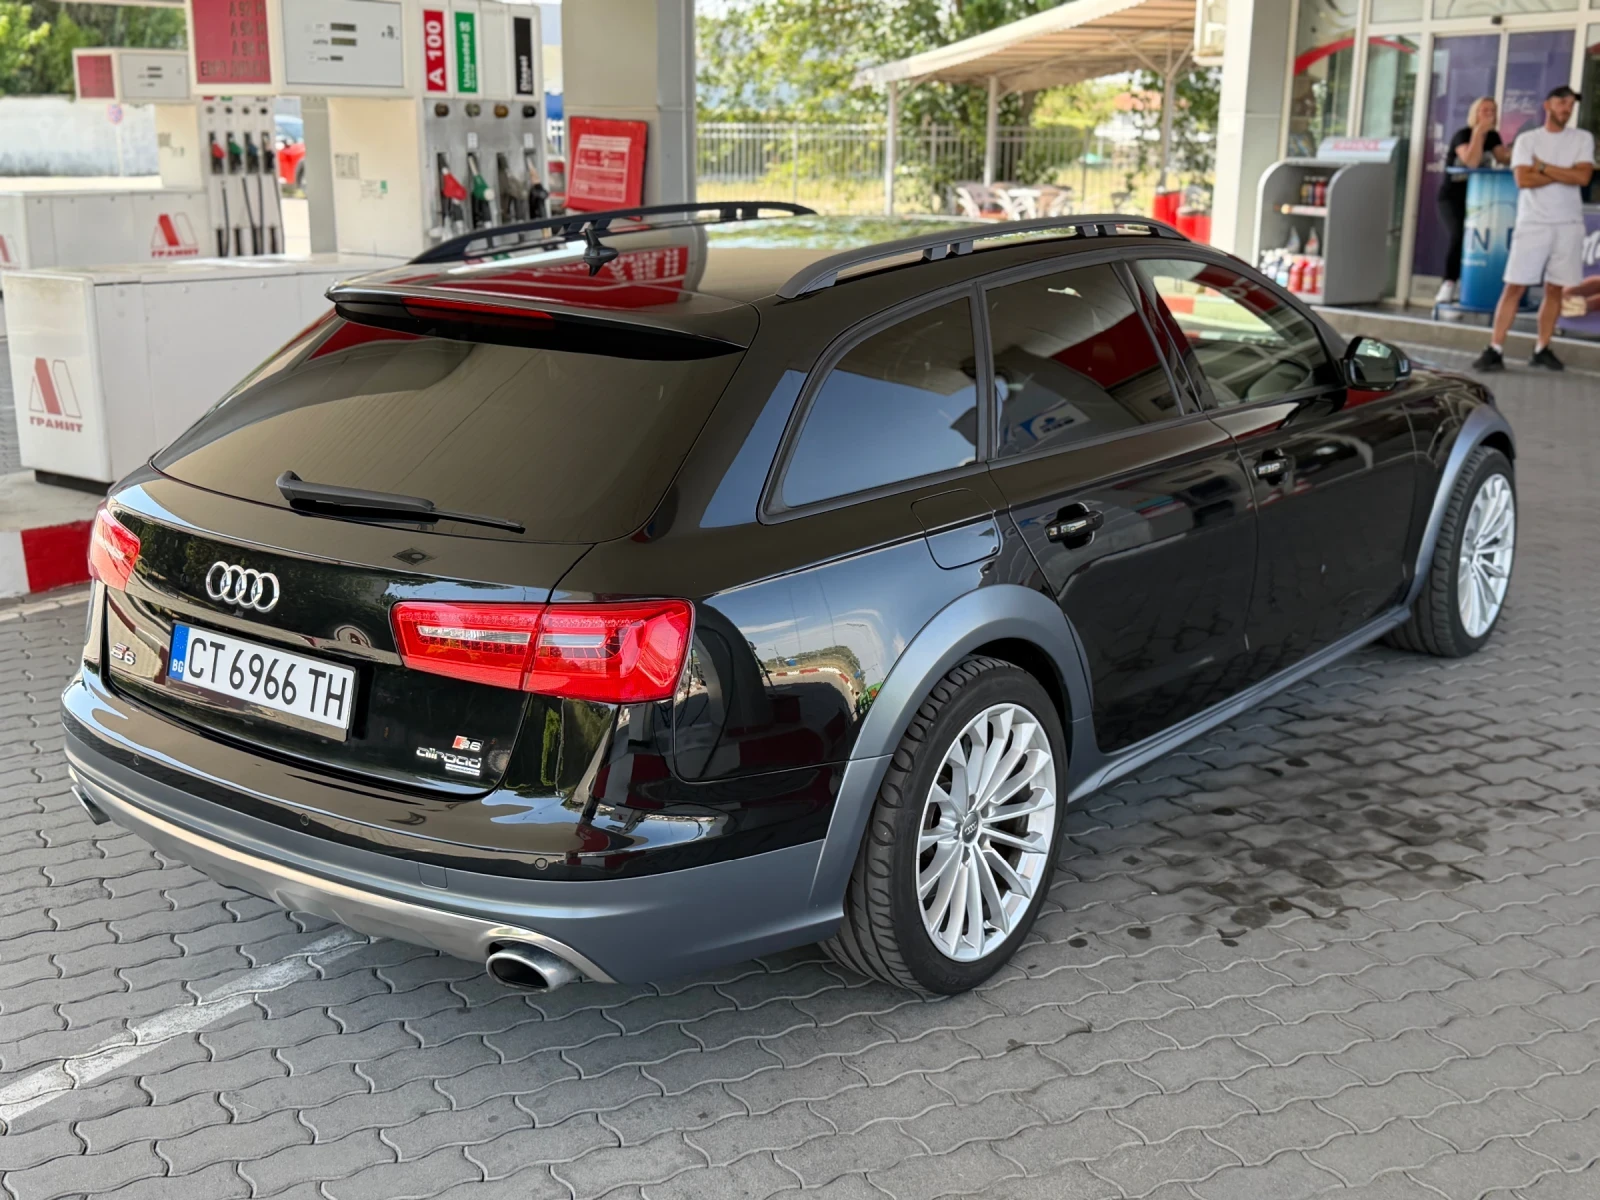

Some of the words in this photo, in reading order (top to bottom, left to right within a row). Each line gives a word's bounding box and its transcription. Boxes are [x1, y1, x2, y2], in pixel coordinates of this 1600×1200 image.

[426, 20, 443, 61] 100
[461, 33, 472, 88] Unleaded
[428, 67, 444, 87] A
[29, 415, 83, 434] ГРАНИТ
[171, 658, 185, 673] BG
[188, 637, 226, 684] CT
[229, 649, 297, 706] 6966
[308, 667, 348, 721] TH
[416, 746, 482, 769] allroad
